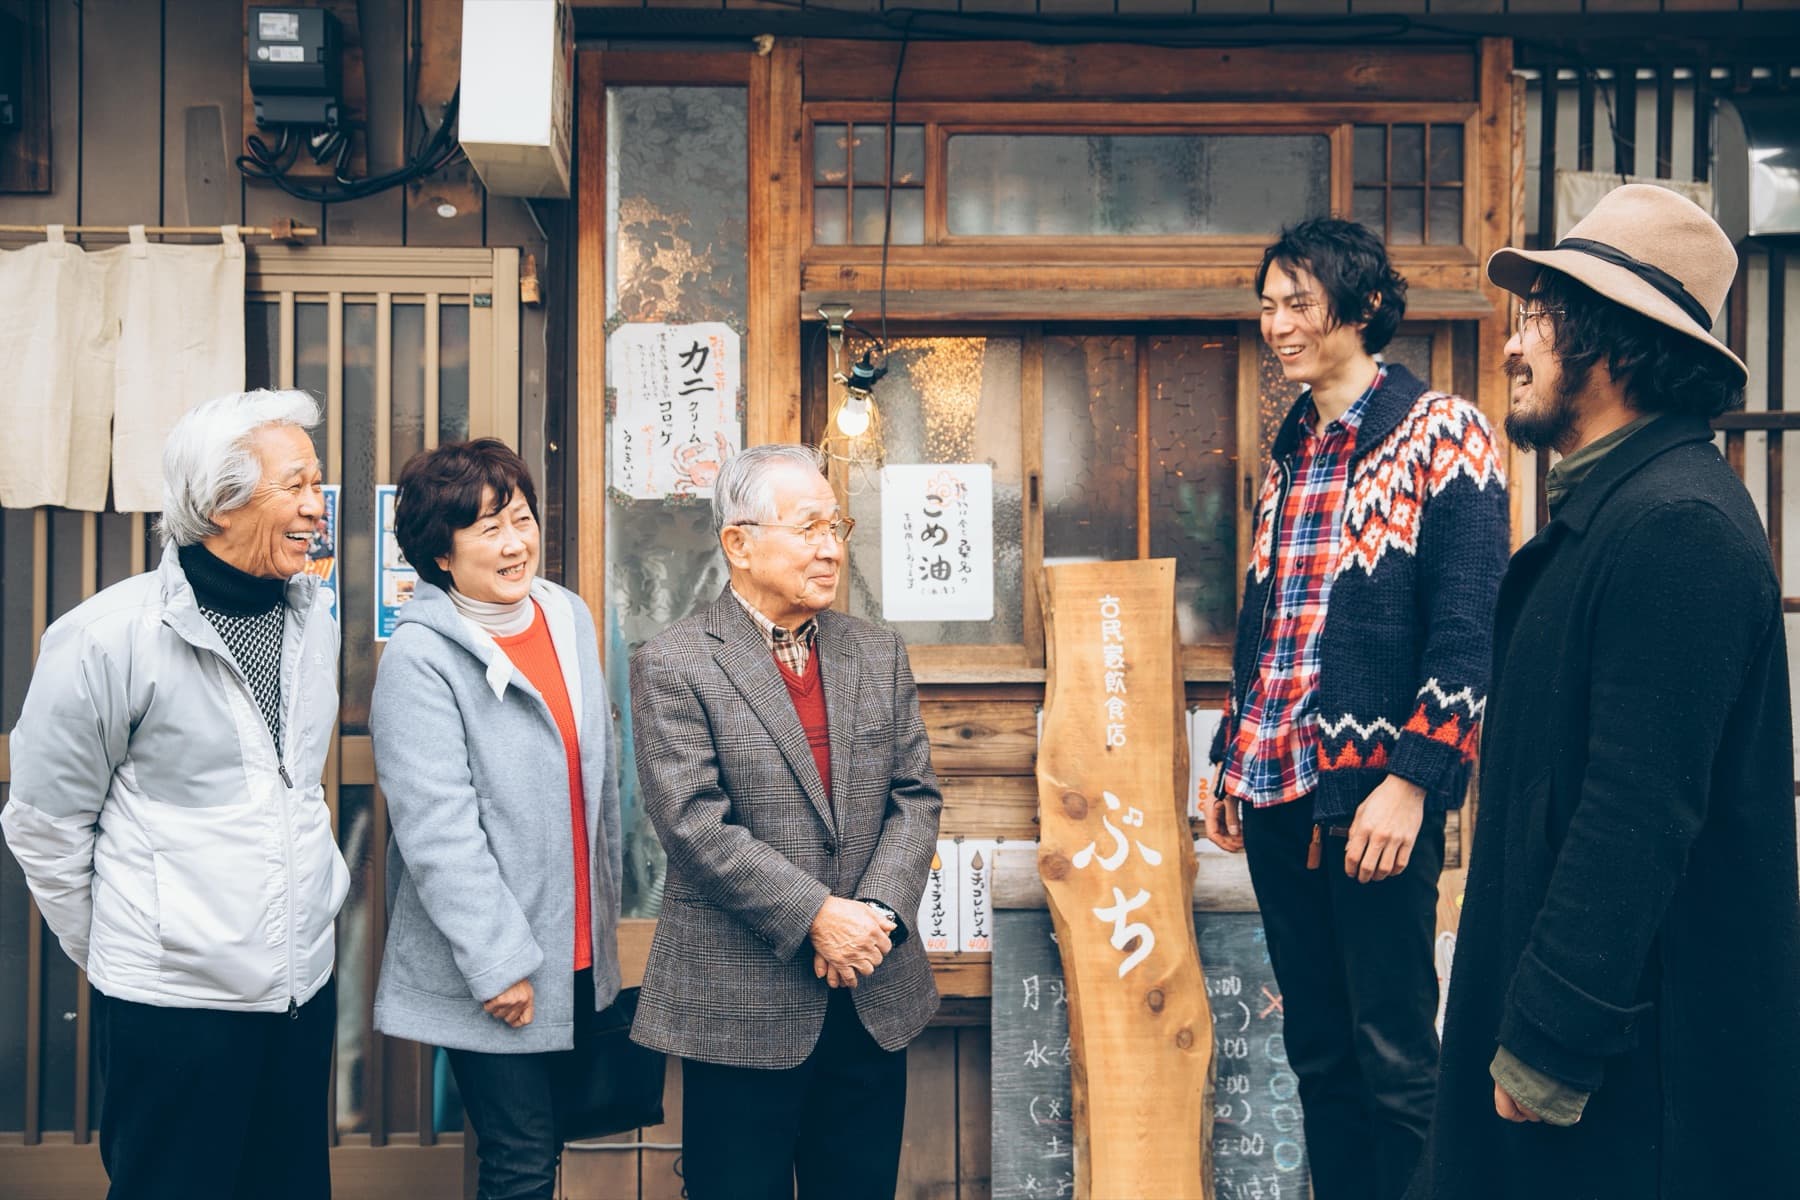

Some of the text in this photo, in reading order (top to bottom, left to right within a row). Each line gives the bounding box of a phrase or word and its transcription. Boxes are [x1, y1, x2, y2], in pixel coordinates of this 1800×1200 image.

[659, 401, 673, 447] コロッケ
[918, 494, 952, 581] こめ油
[1071, 790, 1163, 979] ぶち
